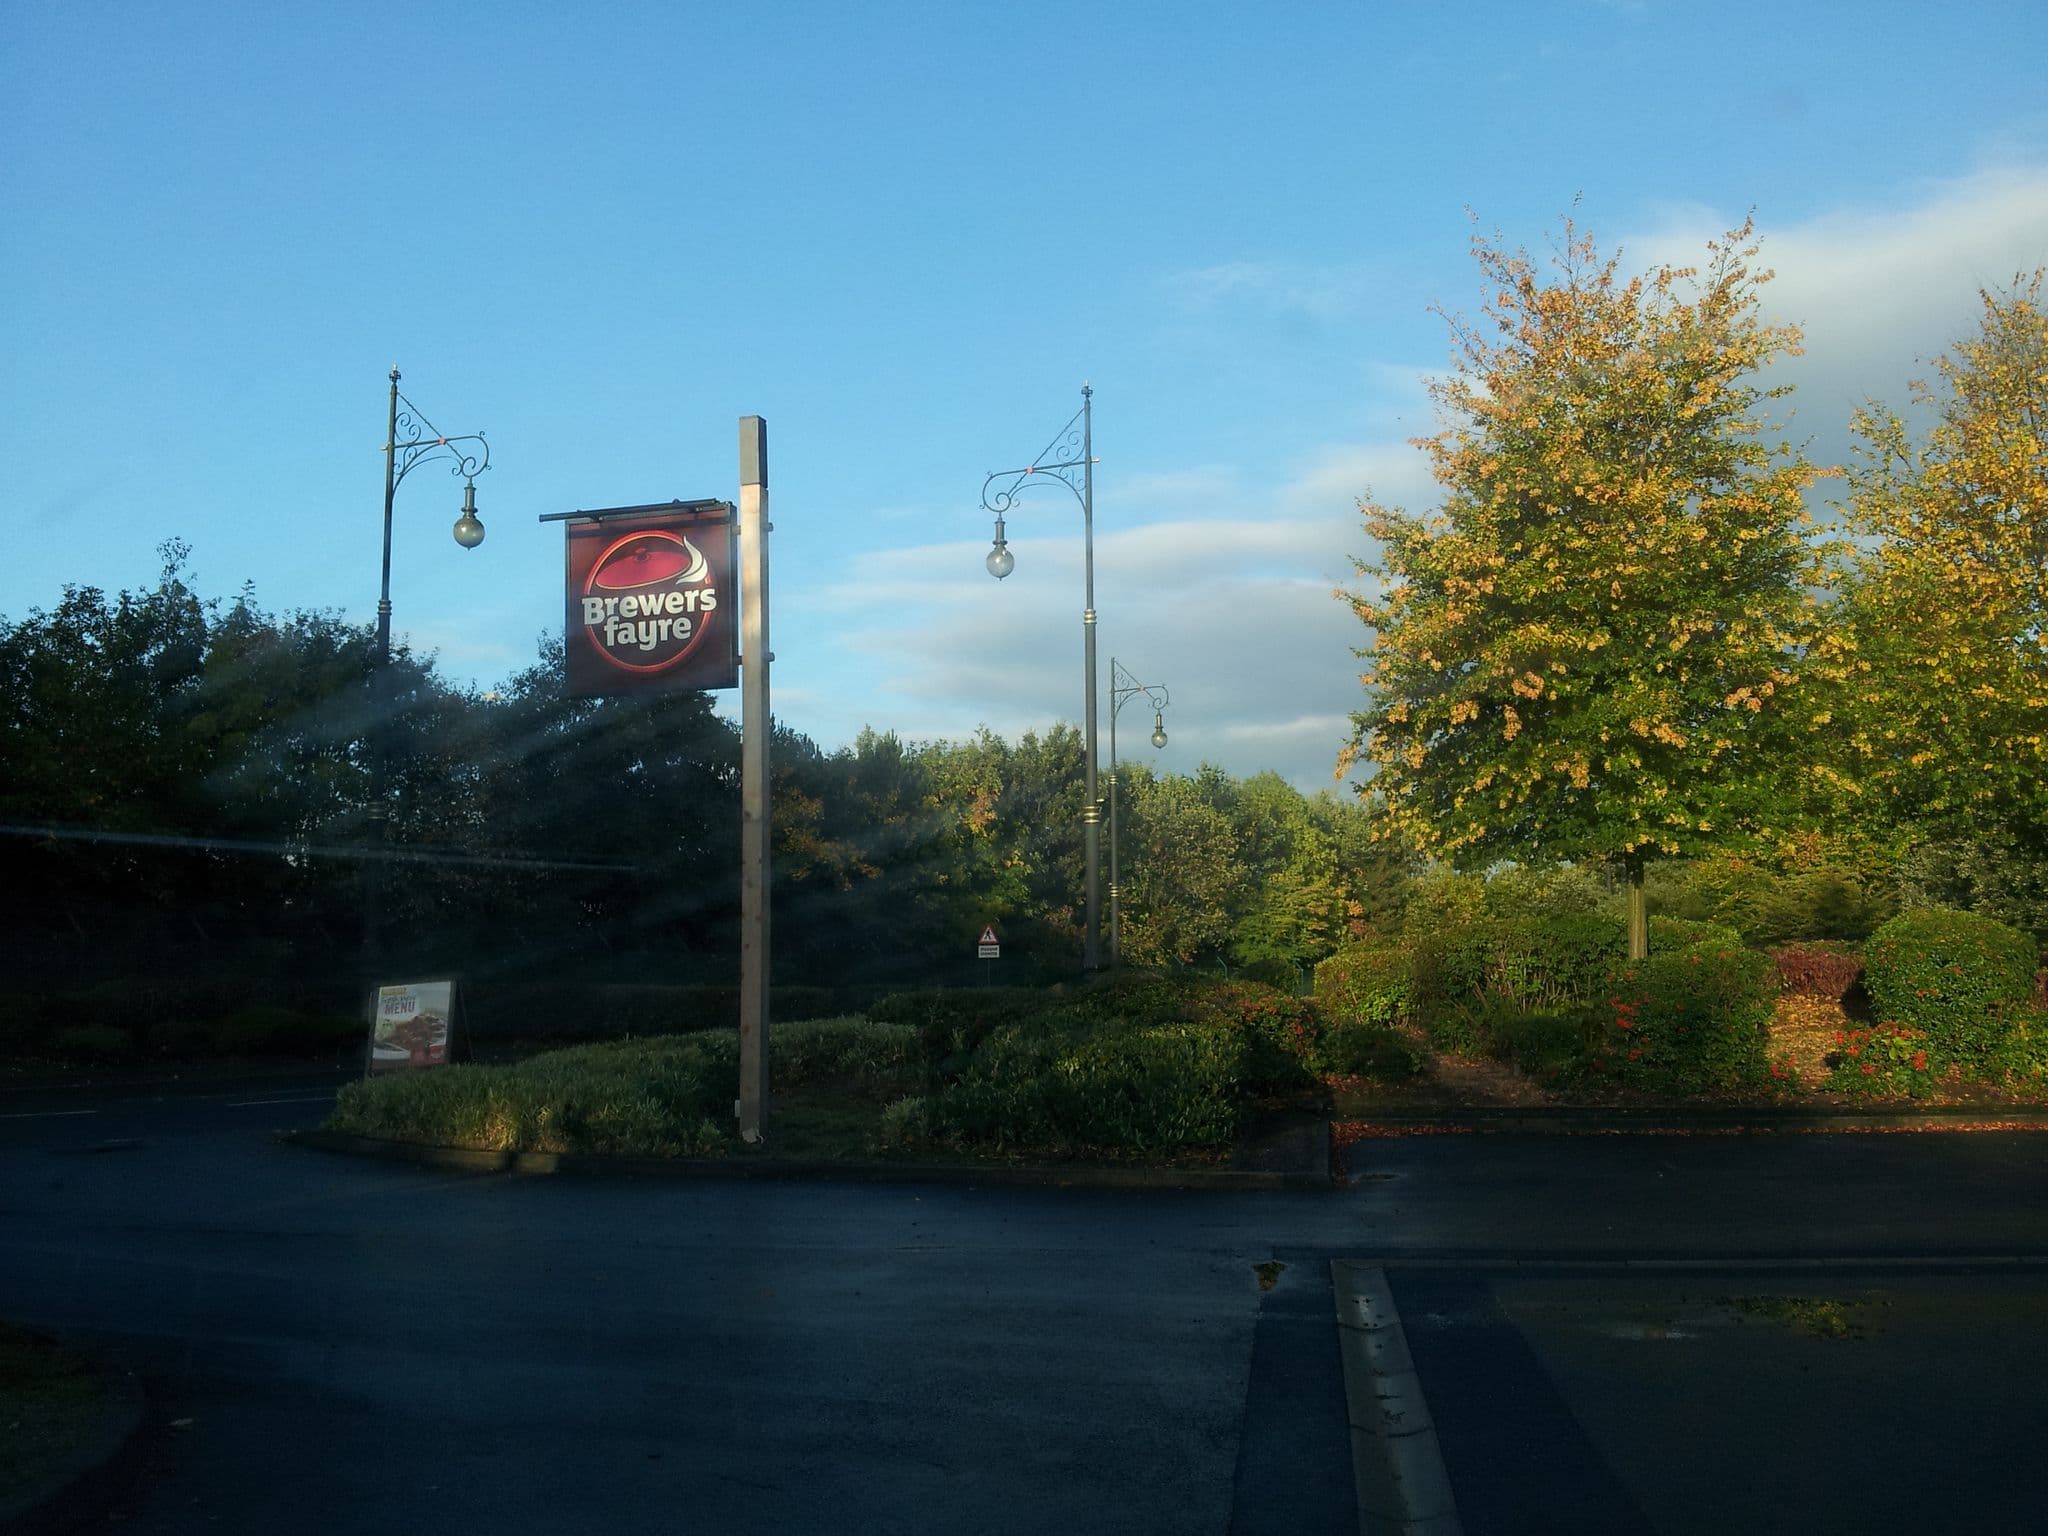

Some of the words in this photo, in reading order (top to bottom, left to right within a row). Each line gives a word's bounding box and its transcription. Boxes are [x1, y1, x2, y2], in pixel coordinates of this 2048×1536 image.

[582, 587, 717, 625] Brewers
[604, 615, 692, 652] fayre
[384, 1000, 415, 1015] MENU
